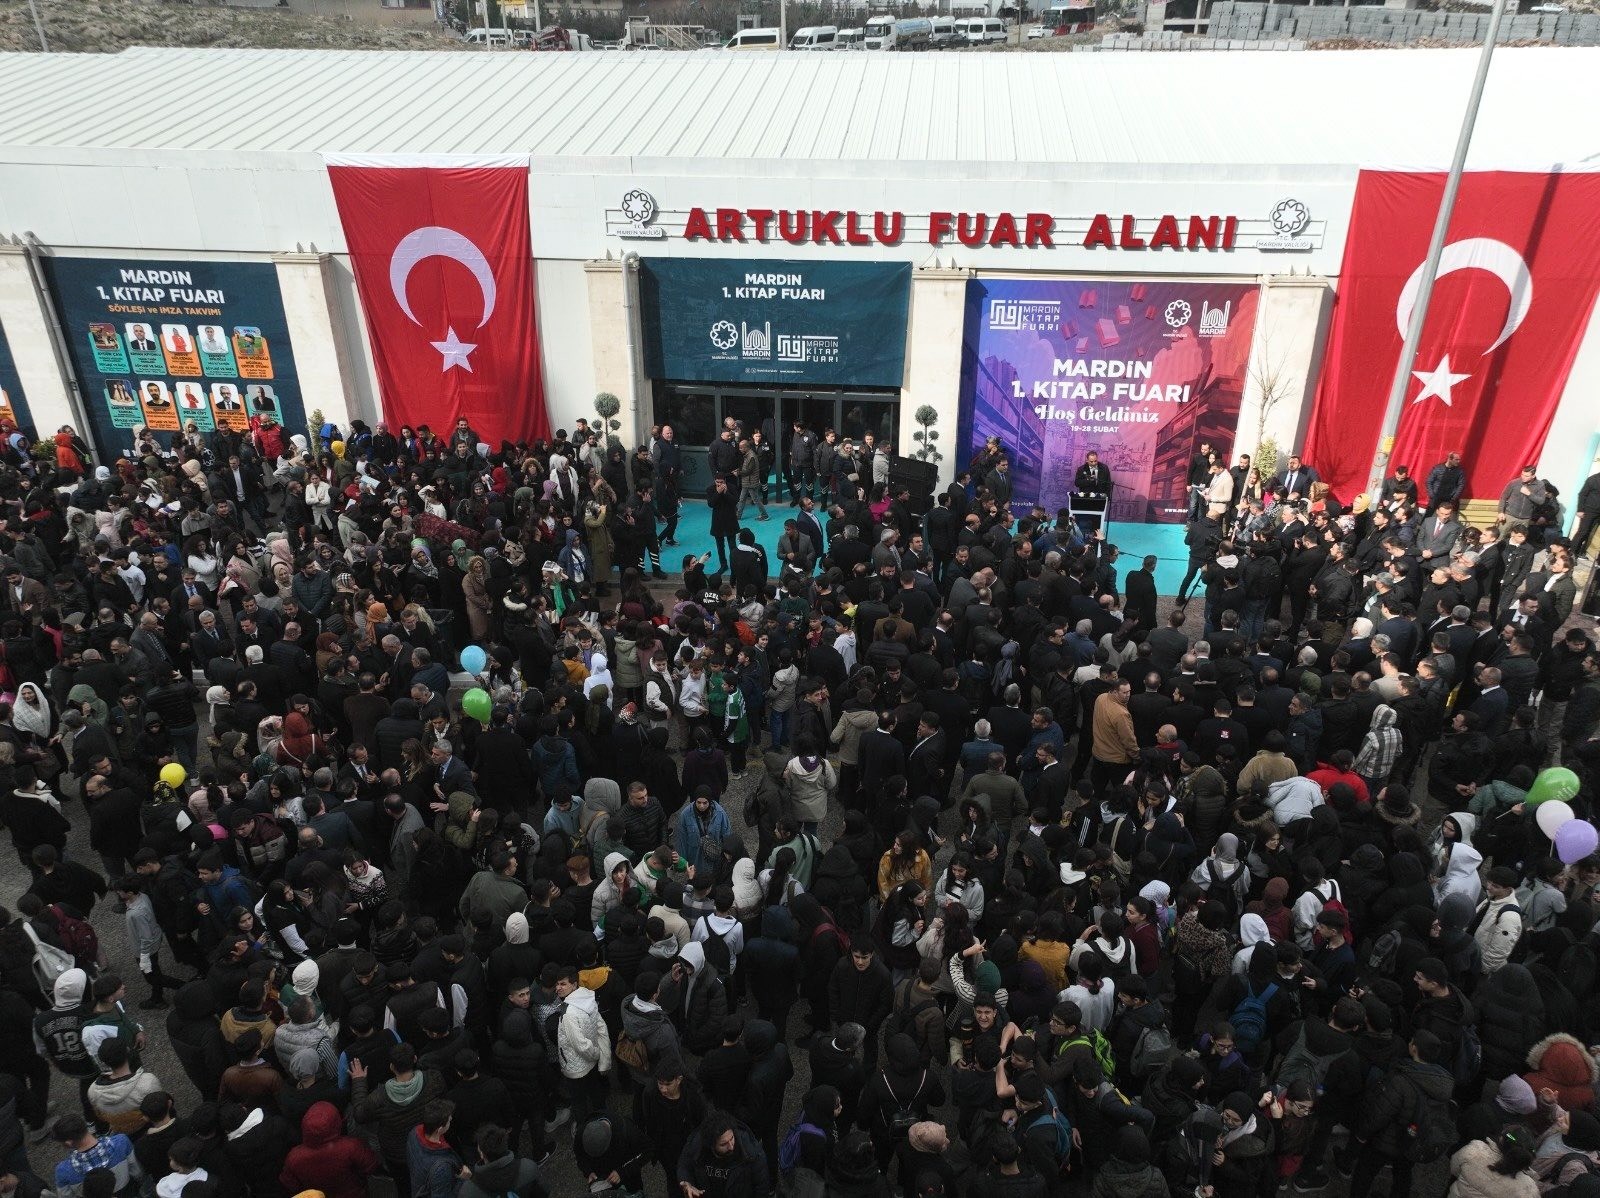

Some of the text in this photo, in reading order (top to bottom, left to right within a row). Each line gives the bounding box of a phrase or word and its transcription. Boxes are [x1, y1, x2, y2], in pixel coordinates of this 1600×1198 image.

[684, 206, 1238, 251] ARTUKLU FUAR ALANI
[121, 269, 192, 286] MARDİN
[745, 273, 802, 286] MARDİN
[97, 286, 225, 304] 1. KİTAP FUARI
[722, 286, 825, 300] 1. KİTAP FUARI
[1023, 305, 1061, 314] MARDİN
[1023, 314, 1060, 322] KİTAP
[1022, 323, 1060, 331] FUARI
[806, 340, 839, 348] MARDİN
[806, 347, 839, 355] KİTAP
[1053, 358, 1153, 379] MARDİN
[1011, 381, 1191, 403] 1. KİTAP FUARI
[1034, 404, 1160, 424] Hoş Geldiniz
[1093, 425, 1120, 435] ŞUBAT
[53, 1031, 81, 1053] 12
